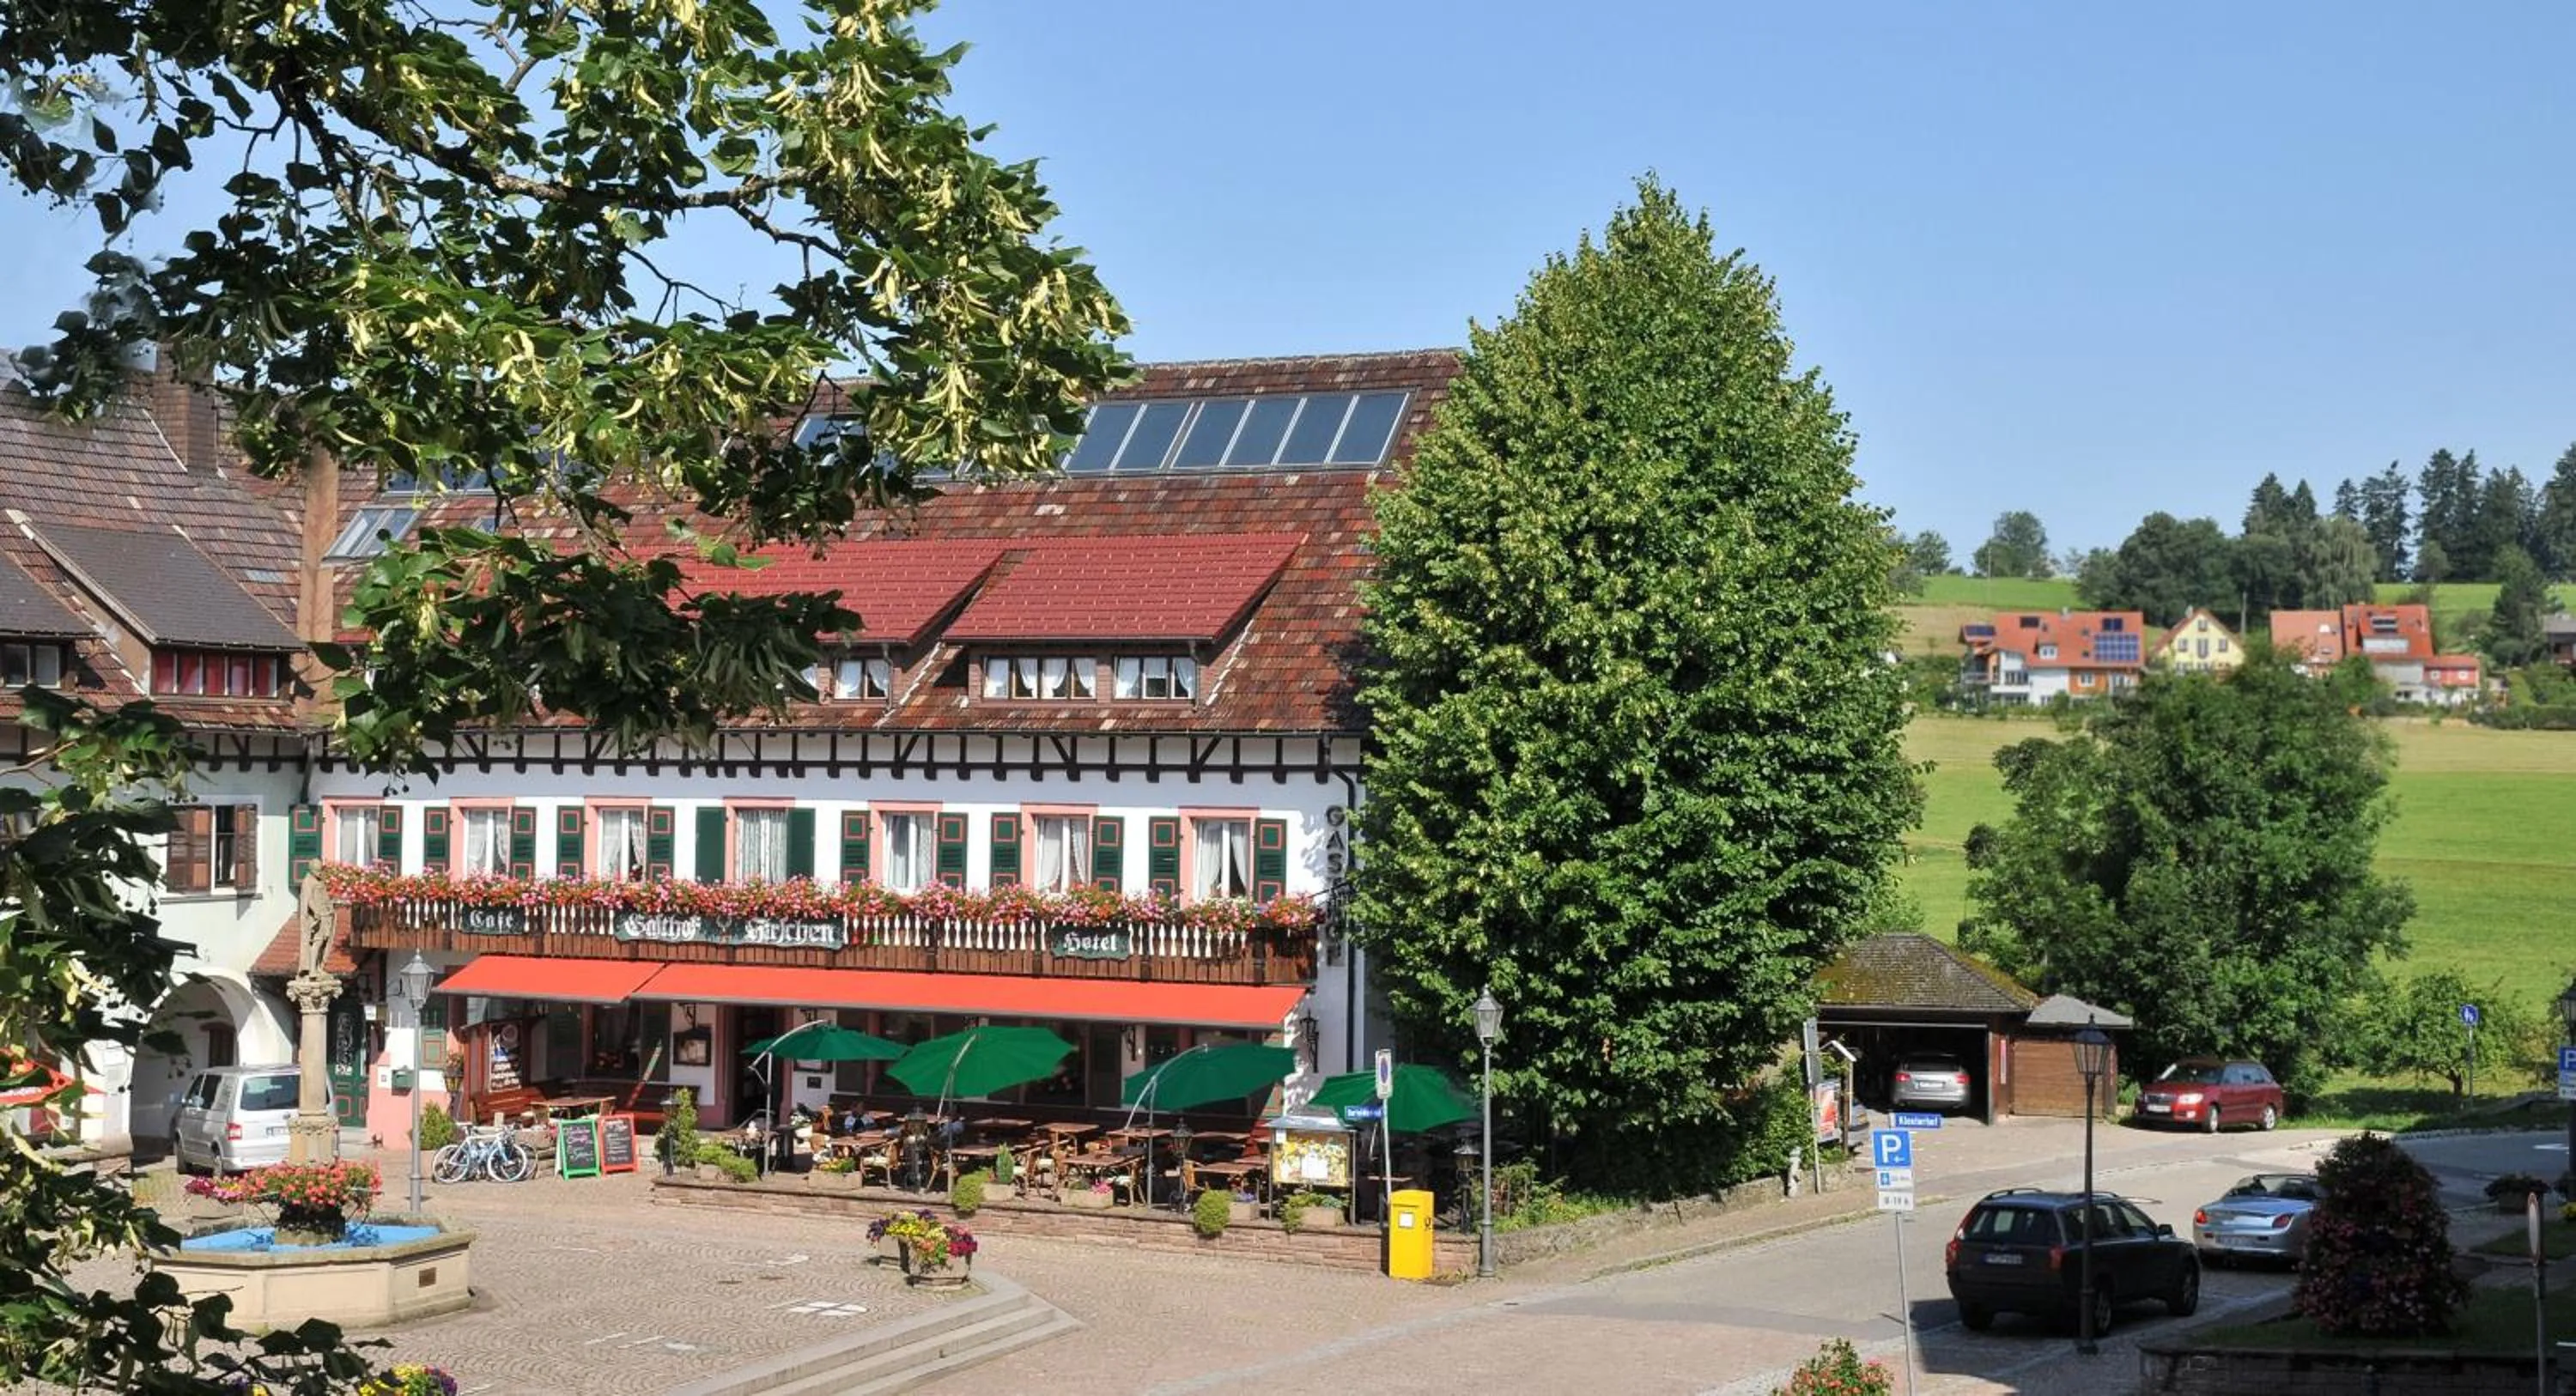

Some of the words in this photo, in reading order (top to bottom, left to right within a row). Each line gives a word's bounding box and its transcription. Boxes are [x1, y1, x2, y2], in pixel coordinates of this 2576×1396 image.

[623, 914, 702, 941] Gasthof
[744, 917, 835, 944] Hirschen
[1063, 932, 1117, 954] Hotel
[1881, 1134, 1902, 1163] P
